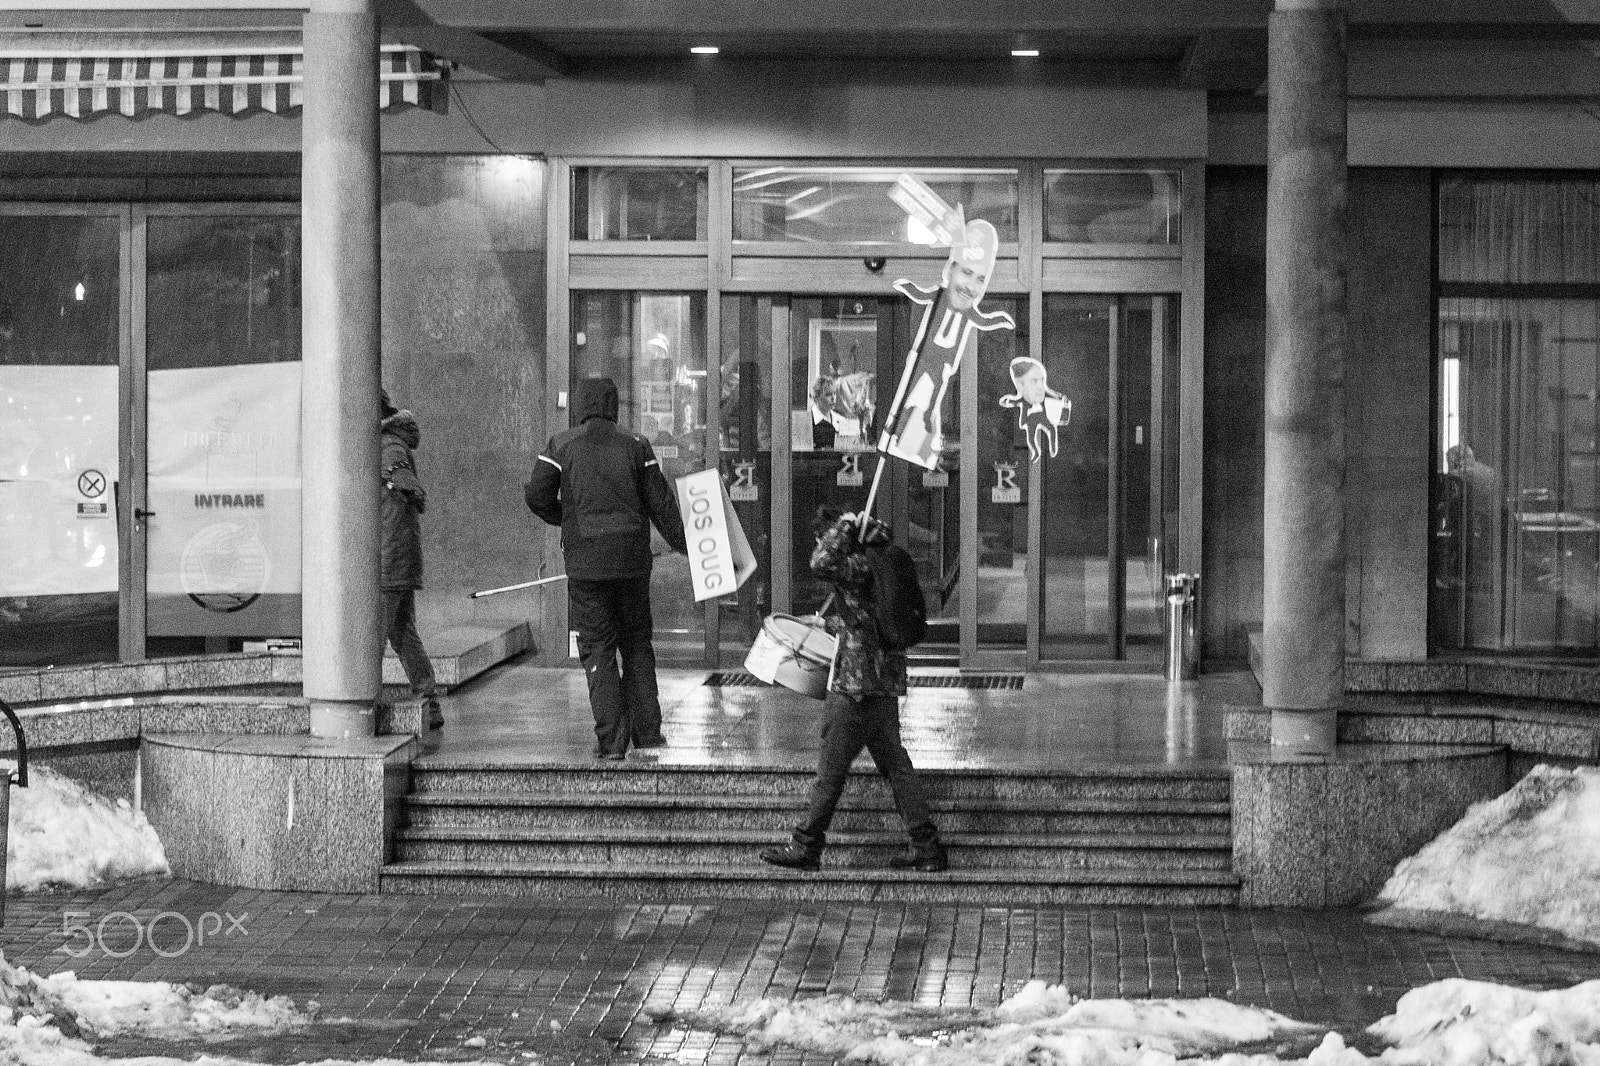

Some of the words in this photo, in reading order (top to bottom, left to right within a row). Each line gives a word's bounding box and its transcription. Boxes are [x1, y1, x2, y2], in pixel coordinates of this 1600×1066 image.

[194, 493, 265, 509] INTRARE
[689, 486, 713, 530] JOS
[698, 537, 723, 590] OUG
